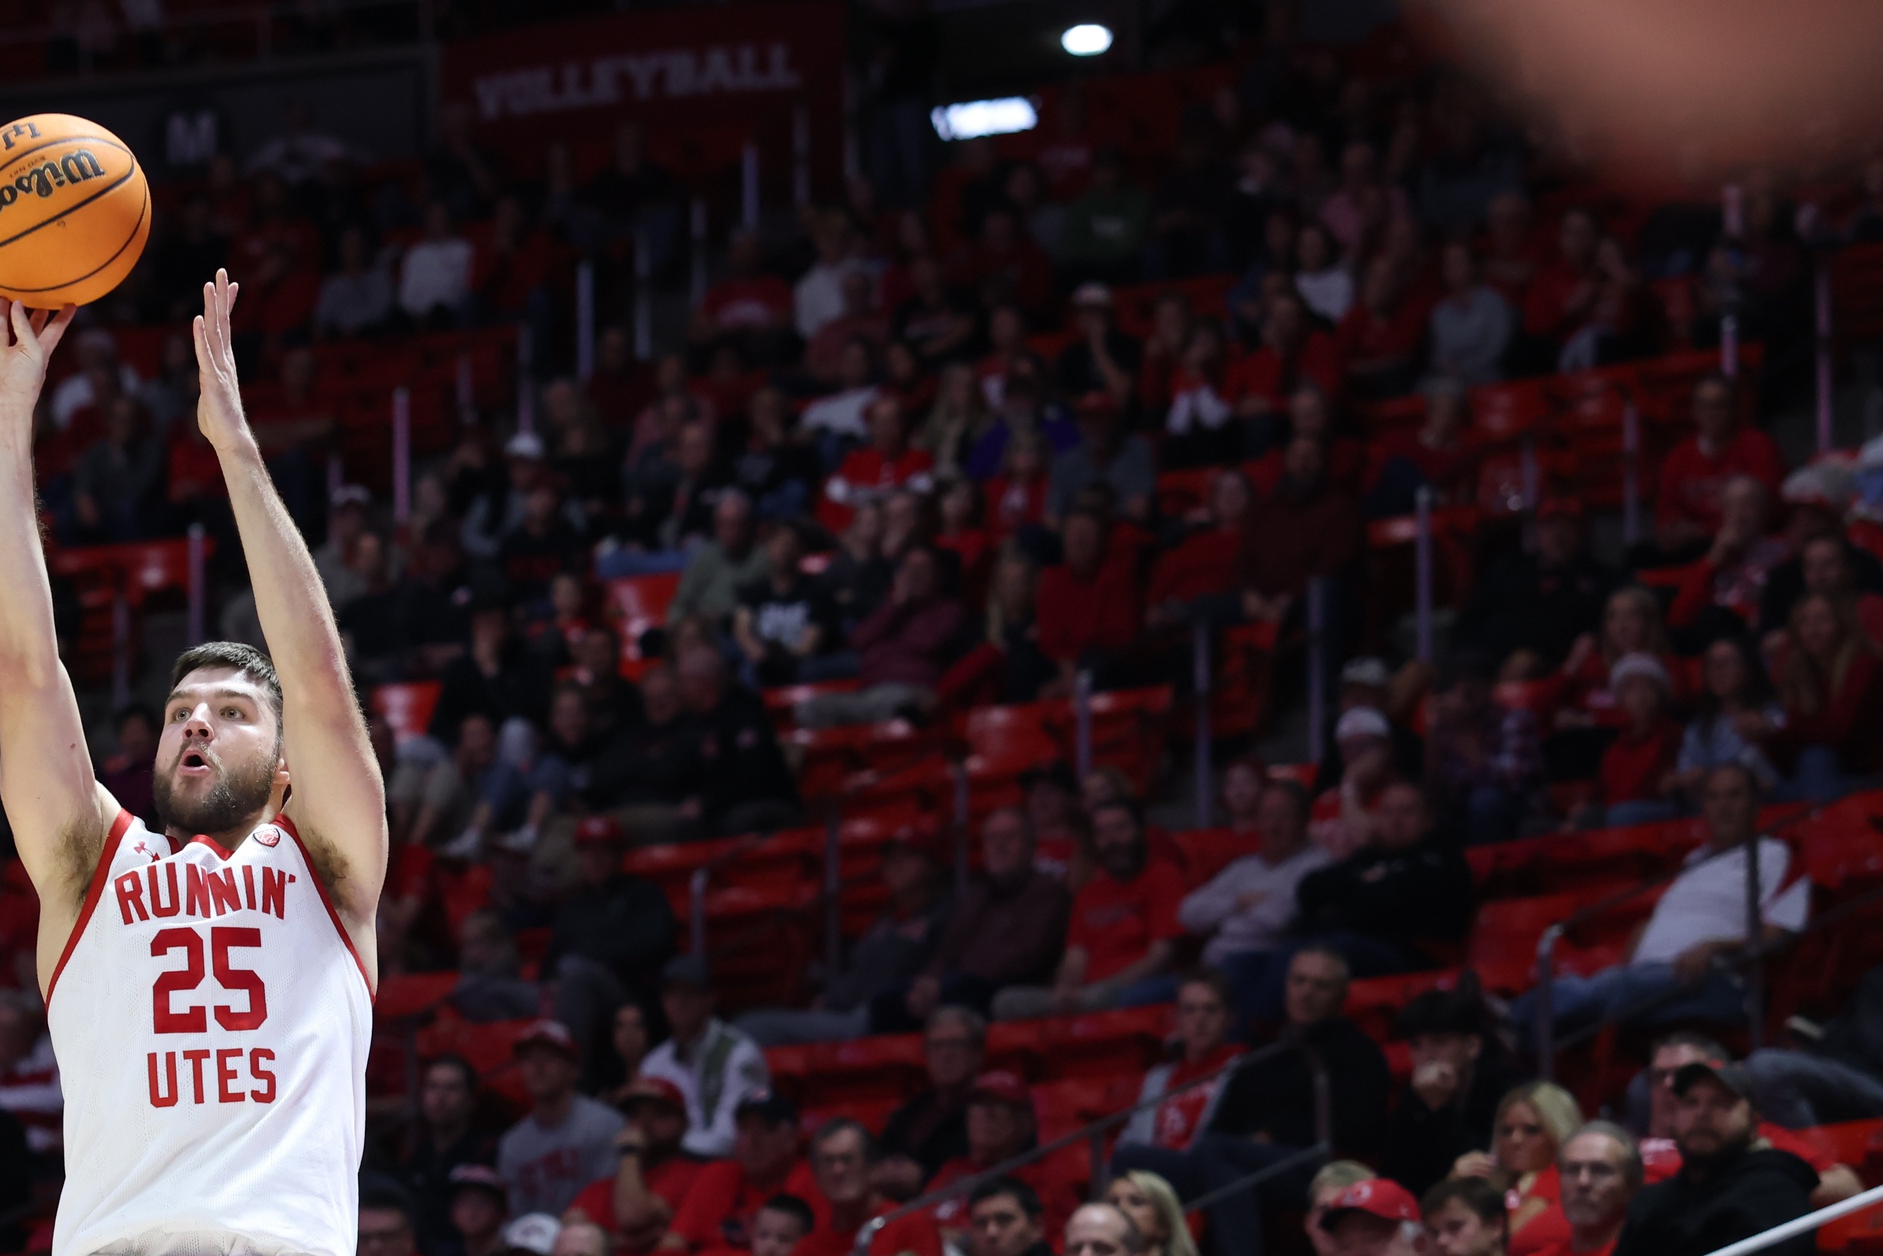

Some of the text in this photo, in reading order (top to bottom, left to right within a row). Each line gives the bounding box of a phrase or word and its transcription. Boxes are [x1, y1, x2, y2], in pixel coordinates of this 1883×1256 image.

[474, 42, 802, 121] VOLLEYBALL
[114, 862, 296, 925] RUNNIN'
[150, 927, 267, 1034] 25
[147, 1047, 276, 1108] UTES
